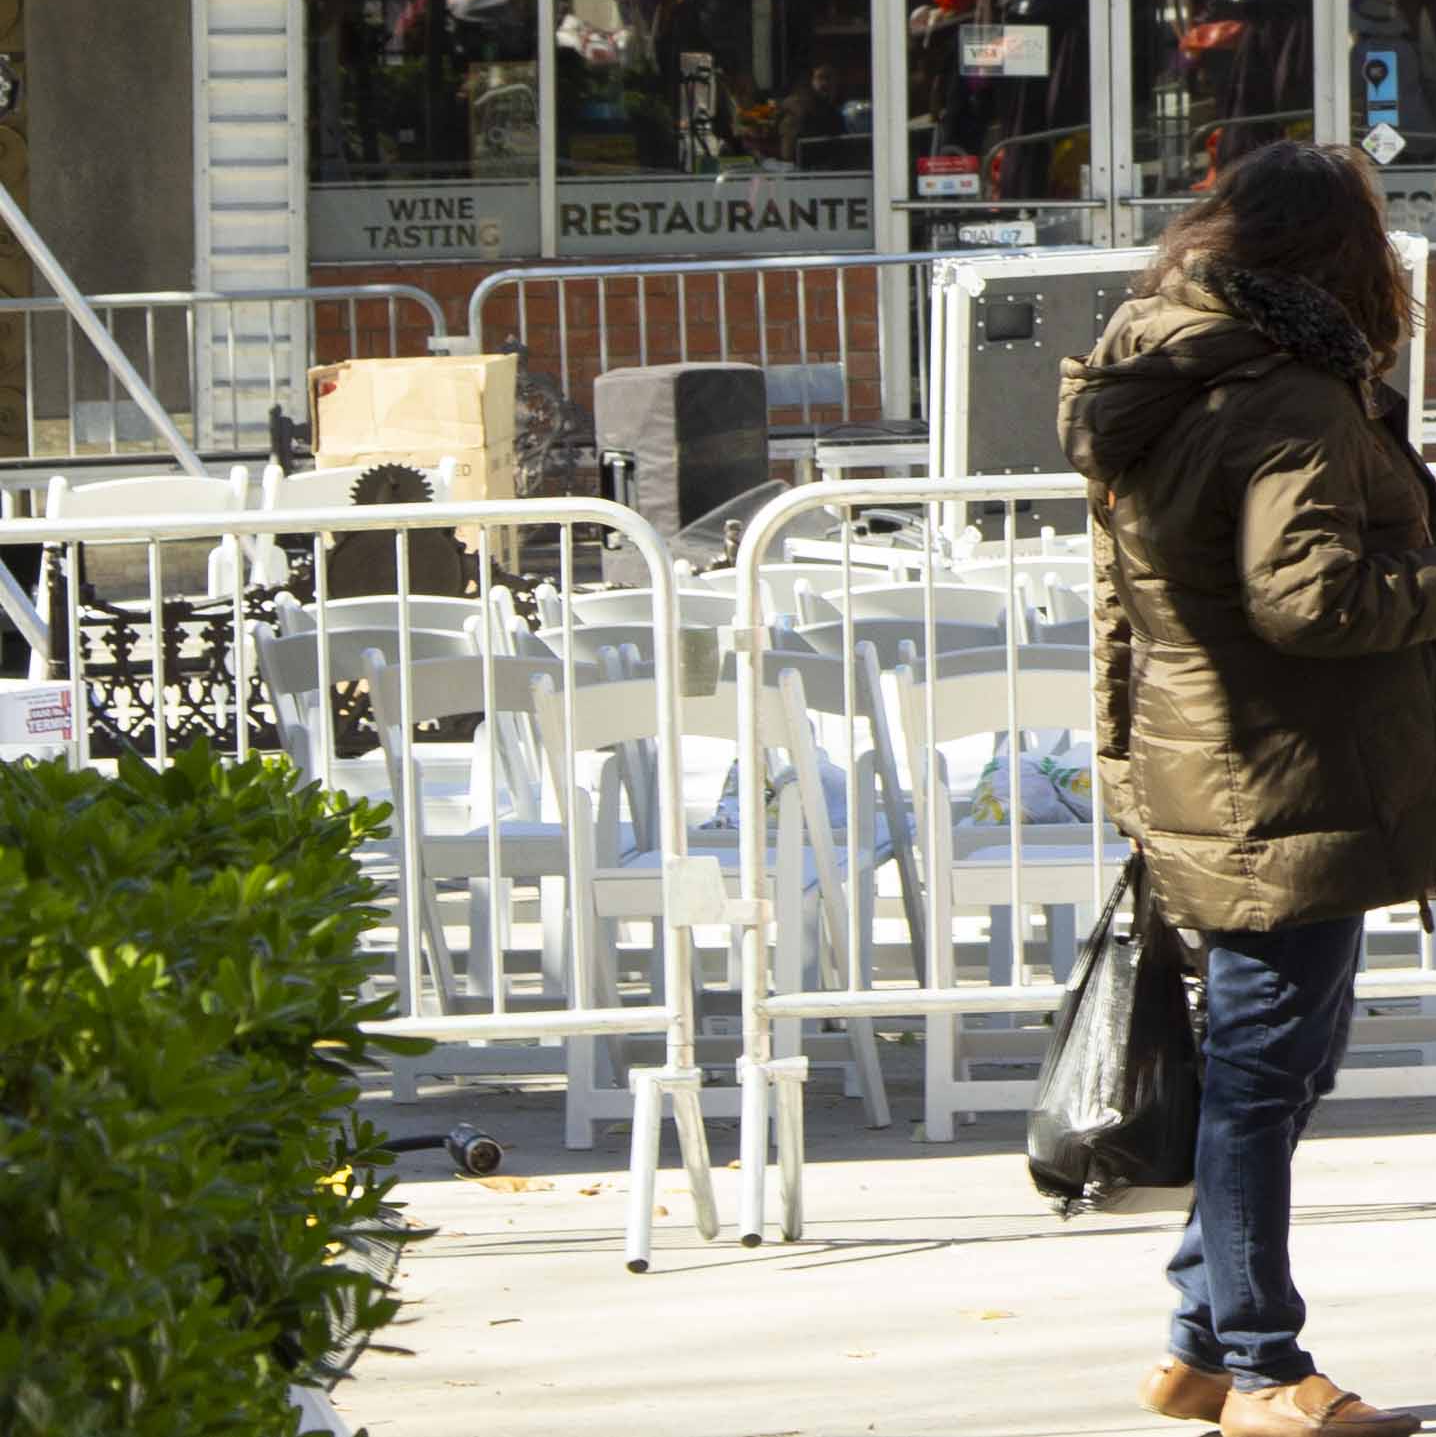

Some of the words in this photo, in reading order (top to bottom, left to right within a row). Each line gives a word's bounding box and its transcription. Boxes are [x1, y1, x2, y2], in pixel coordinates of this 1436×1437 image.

[387, 197, 474, 222] WINE
[560, 196, 868, 237] RESTAURANTE
[364, 222, 500, 249] TASTING
